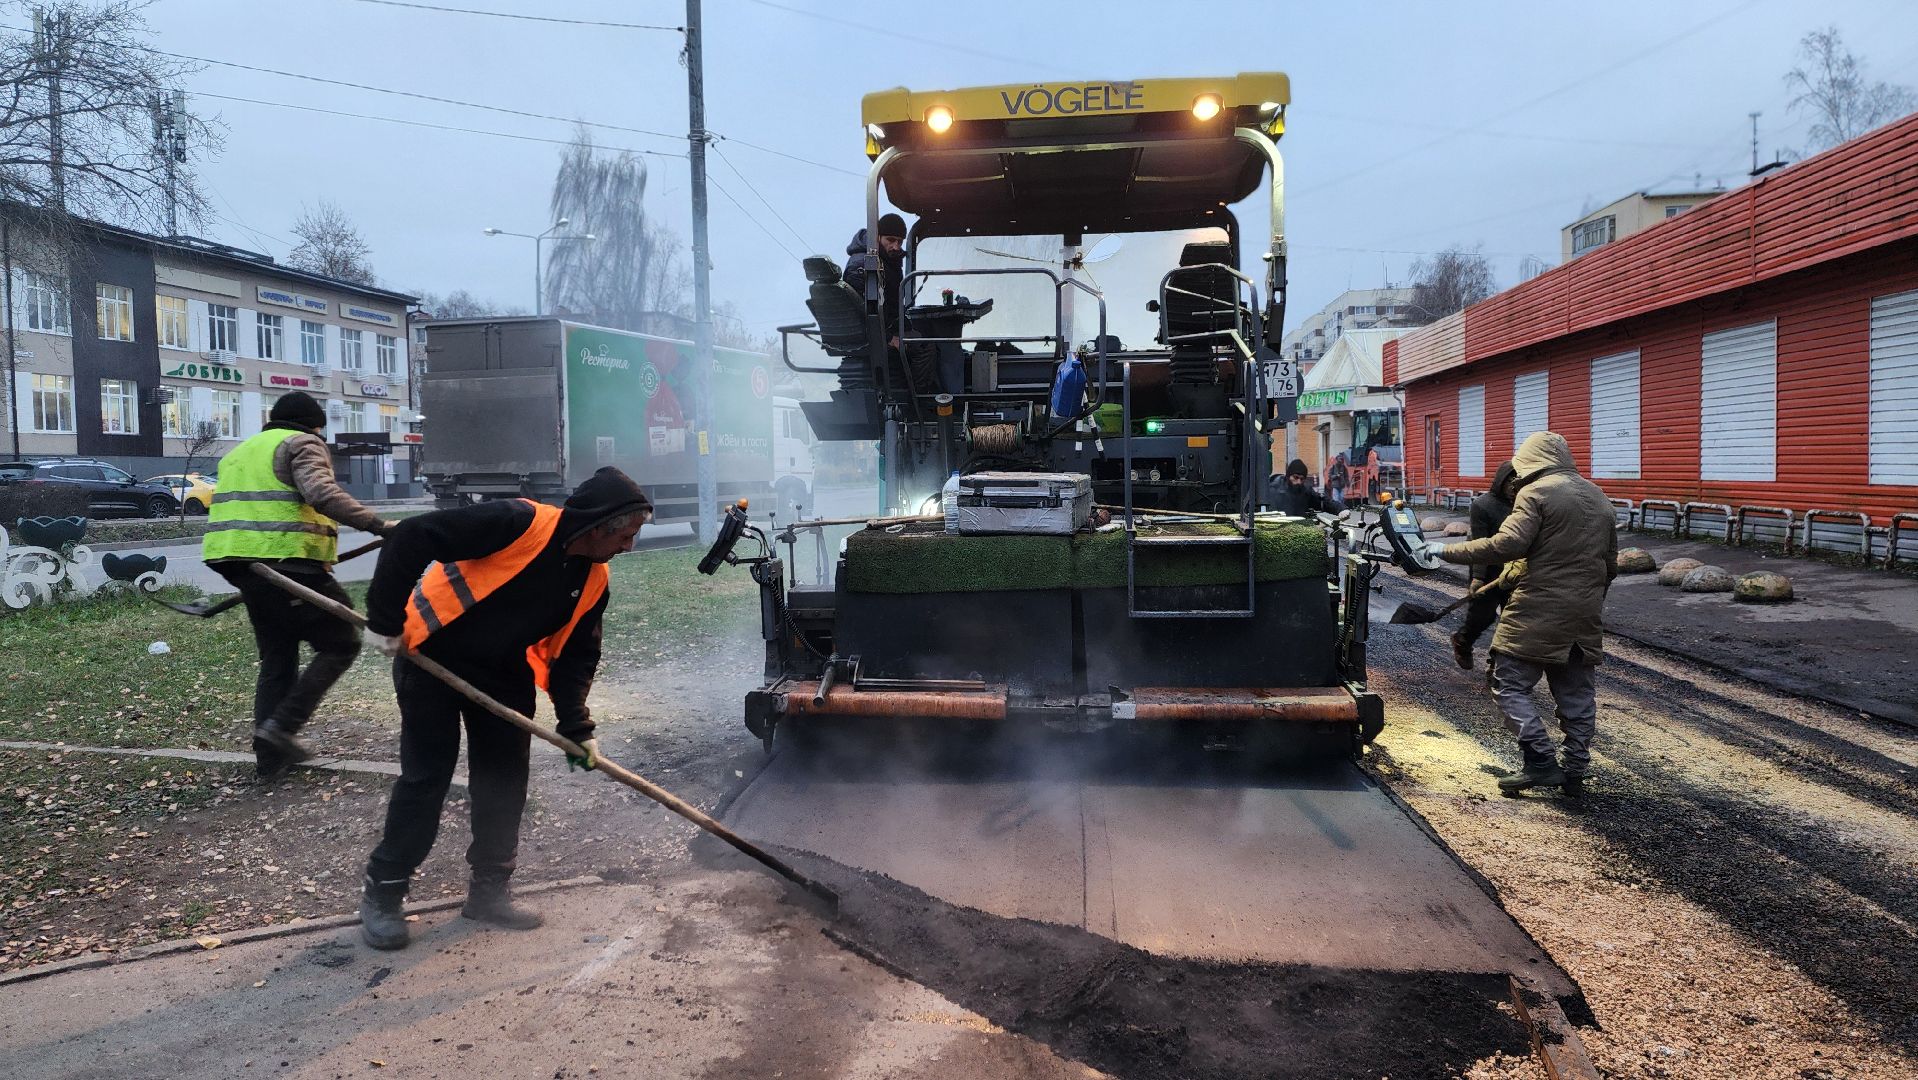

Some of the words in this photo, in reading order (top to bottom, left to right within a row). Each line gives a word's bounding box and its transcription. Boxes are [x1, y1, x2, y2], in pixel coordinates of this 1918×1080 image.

[1000, 83, 1145, 115] VÖGELE
[187, 363, 243, 382] ОБУВЬ
[1255, 361, 1290, 377] 473
[1278, 379, 1294, 391] 76
